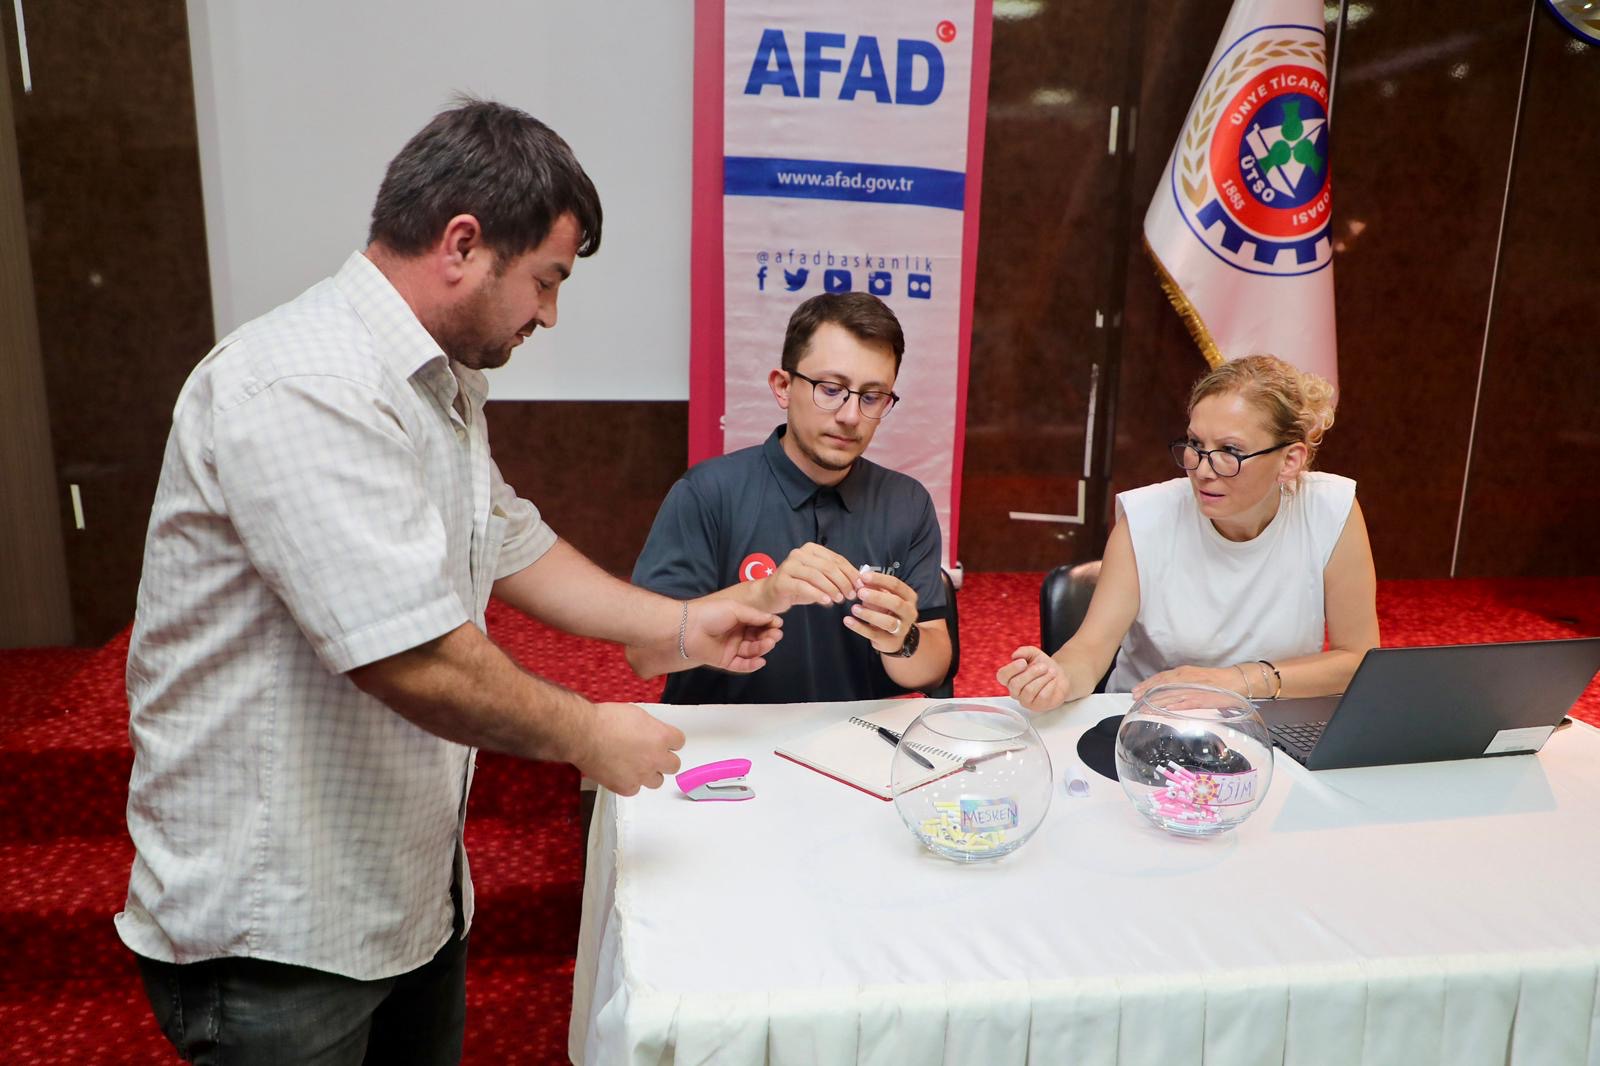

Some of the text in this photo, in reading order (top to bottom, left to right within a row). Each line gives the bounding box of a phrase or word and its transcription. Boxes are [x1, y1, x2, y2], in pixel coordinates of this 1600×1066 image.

[744, 29, 945, 106] AFAD
[777, 170, 914, 193] www.afad.gov.tr
[1240, 154, 1276, 202] ÜTSO
[756, 249, 932, 273] @afadbaskanlik
[963, 804, 1018, 825] MESKEN
